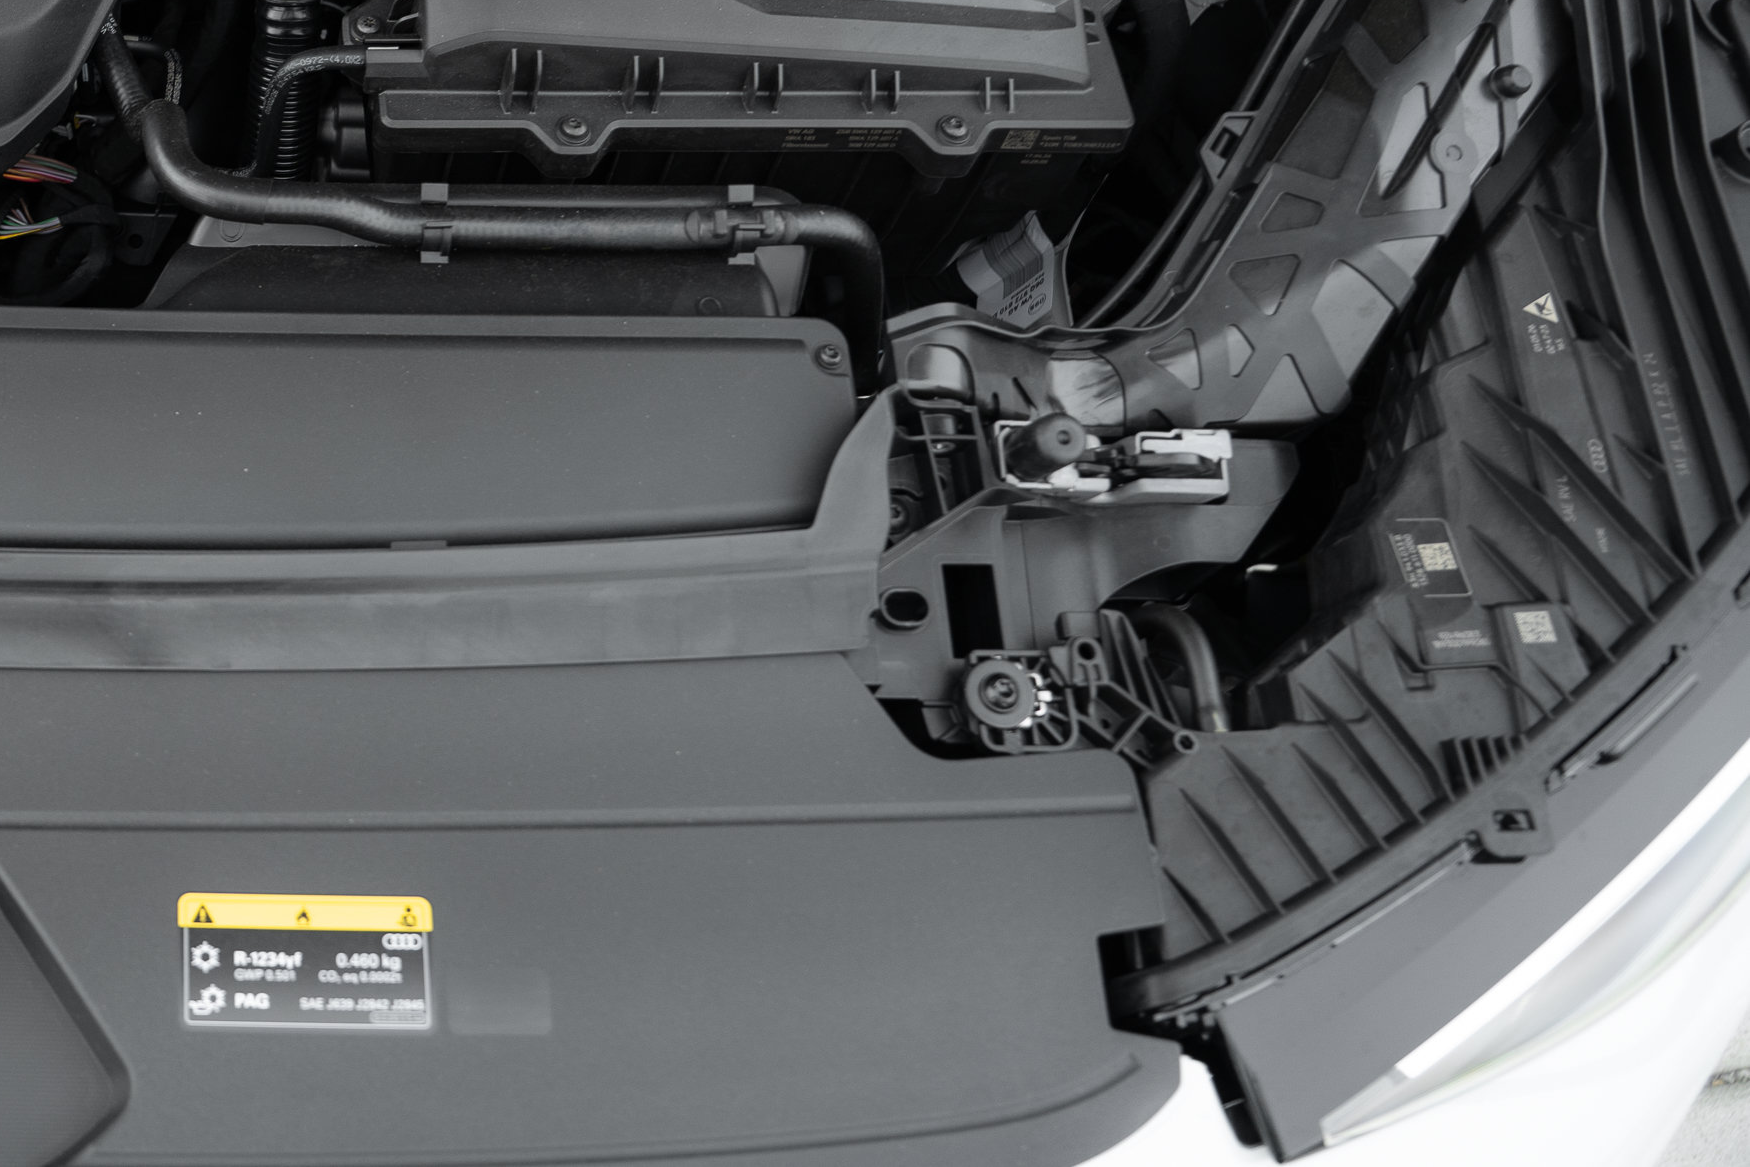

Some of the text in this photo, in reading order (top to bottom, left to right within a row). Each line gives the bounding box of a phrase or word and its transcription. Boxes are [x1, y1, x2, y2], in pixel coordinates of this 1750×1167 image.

[234, 951, 302, 970] R-1234yf
[381, 954, 402, 972] kg
[235, 992, 270, 1009] PAG
[300, 998, 325, 1010] SAE
